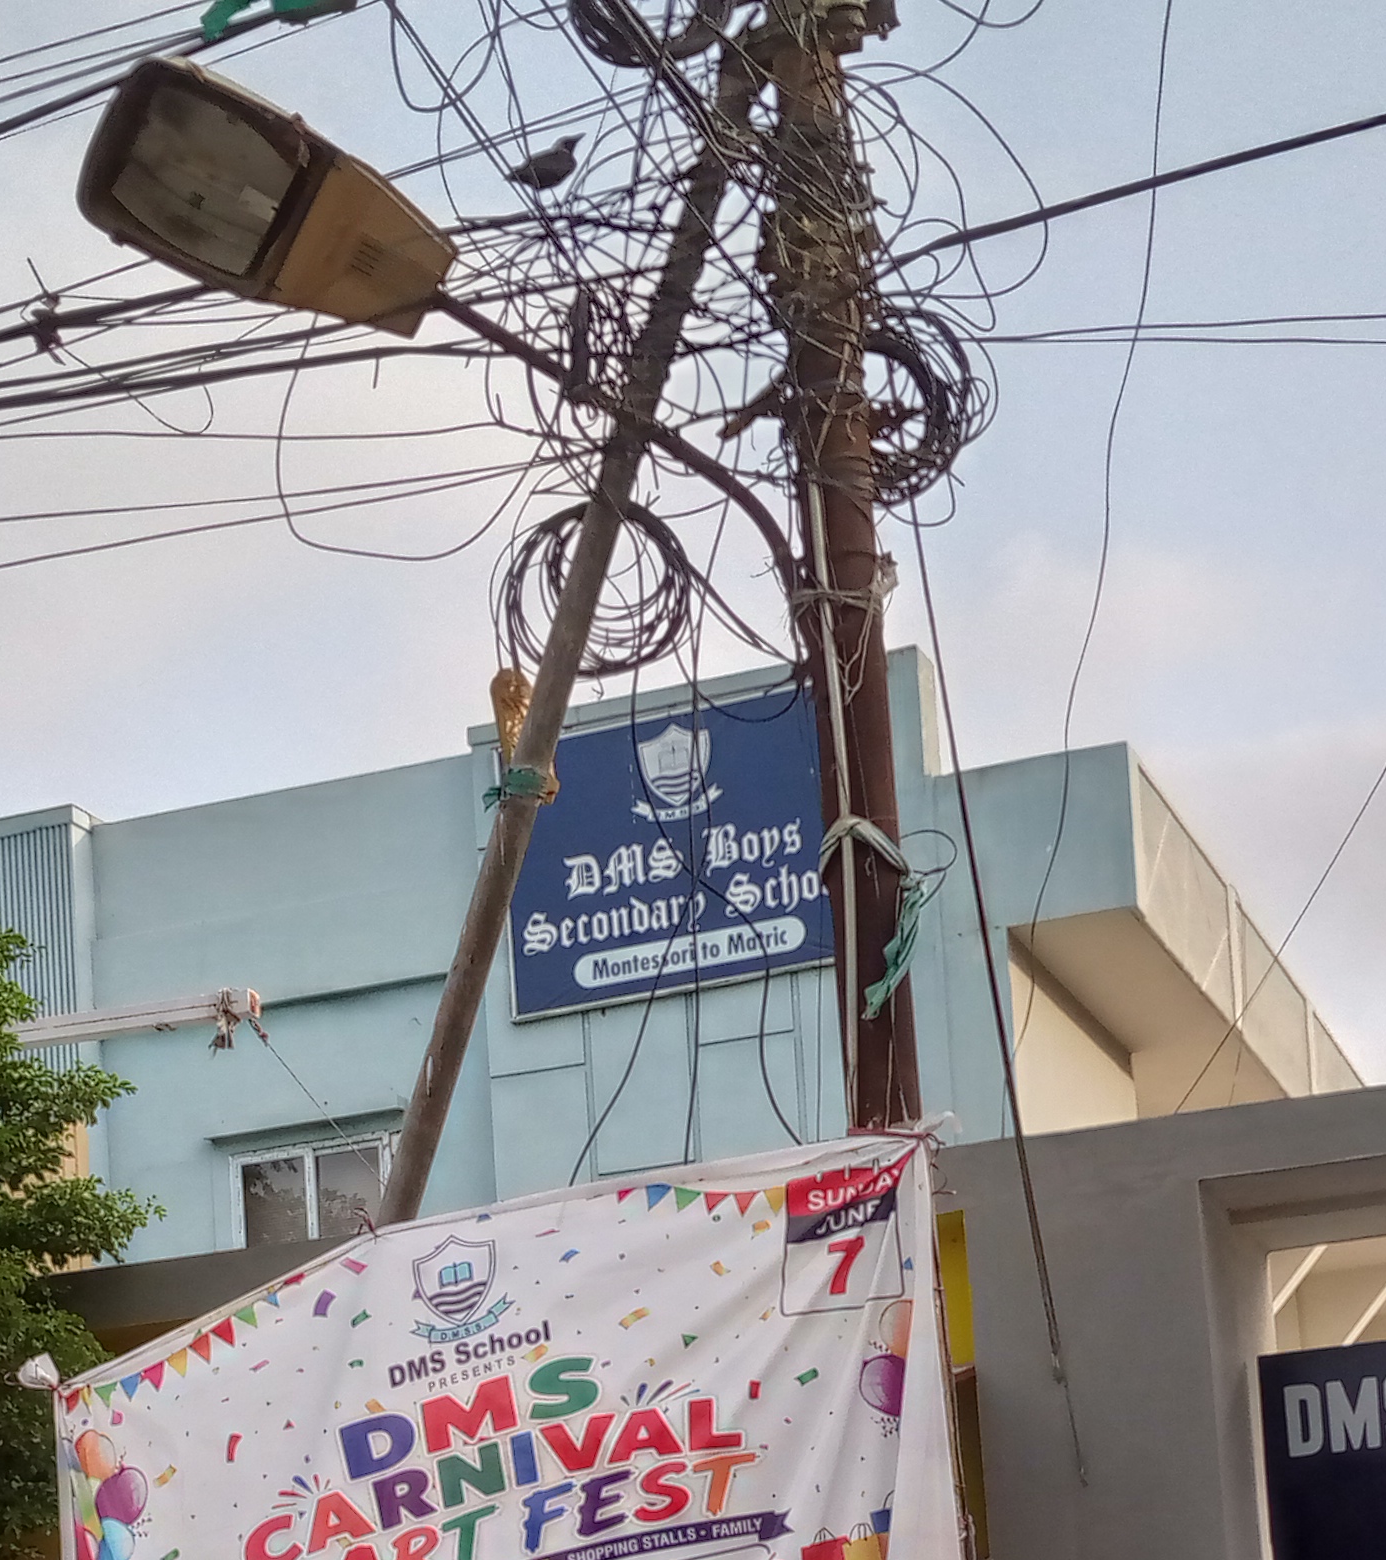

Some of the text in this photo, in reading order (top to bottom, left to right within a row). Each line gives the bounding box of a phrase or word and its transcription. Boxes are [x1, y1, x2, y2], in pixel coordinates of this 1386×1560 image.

[563, 818, 803, 901] DMS Boys
[522, 863, 830, 957] Secondary Scho
[591, 925, 789, 982] Montessori to Matric
[827, 1235, 865, 1296] 7
[388, 1319, 552, 1389] DMS School
[428, 1355, 516, 1392] PRESENTS
[338, 1355, 601, 1481] DMS
[522, 1453, 760, 1554] FEST
[642, 1528, 697, 1551] STALLS
[712, 1517, 764, 1539] FAMILY
